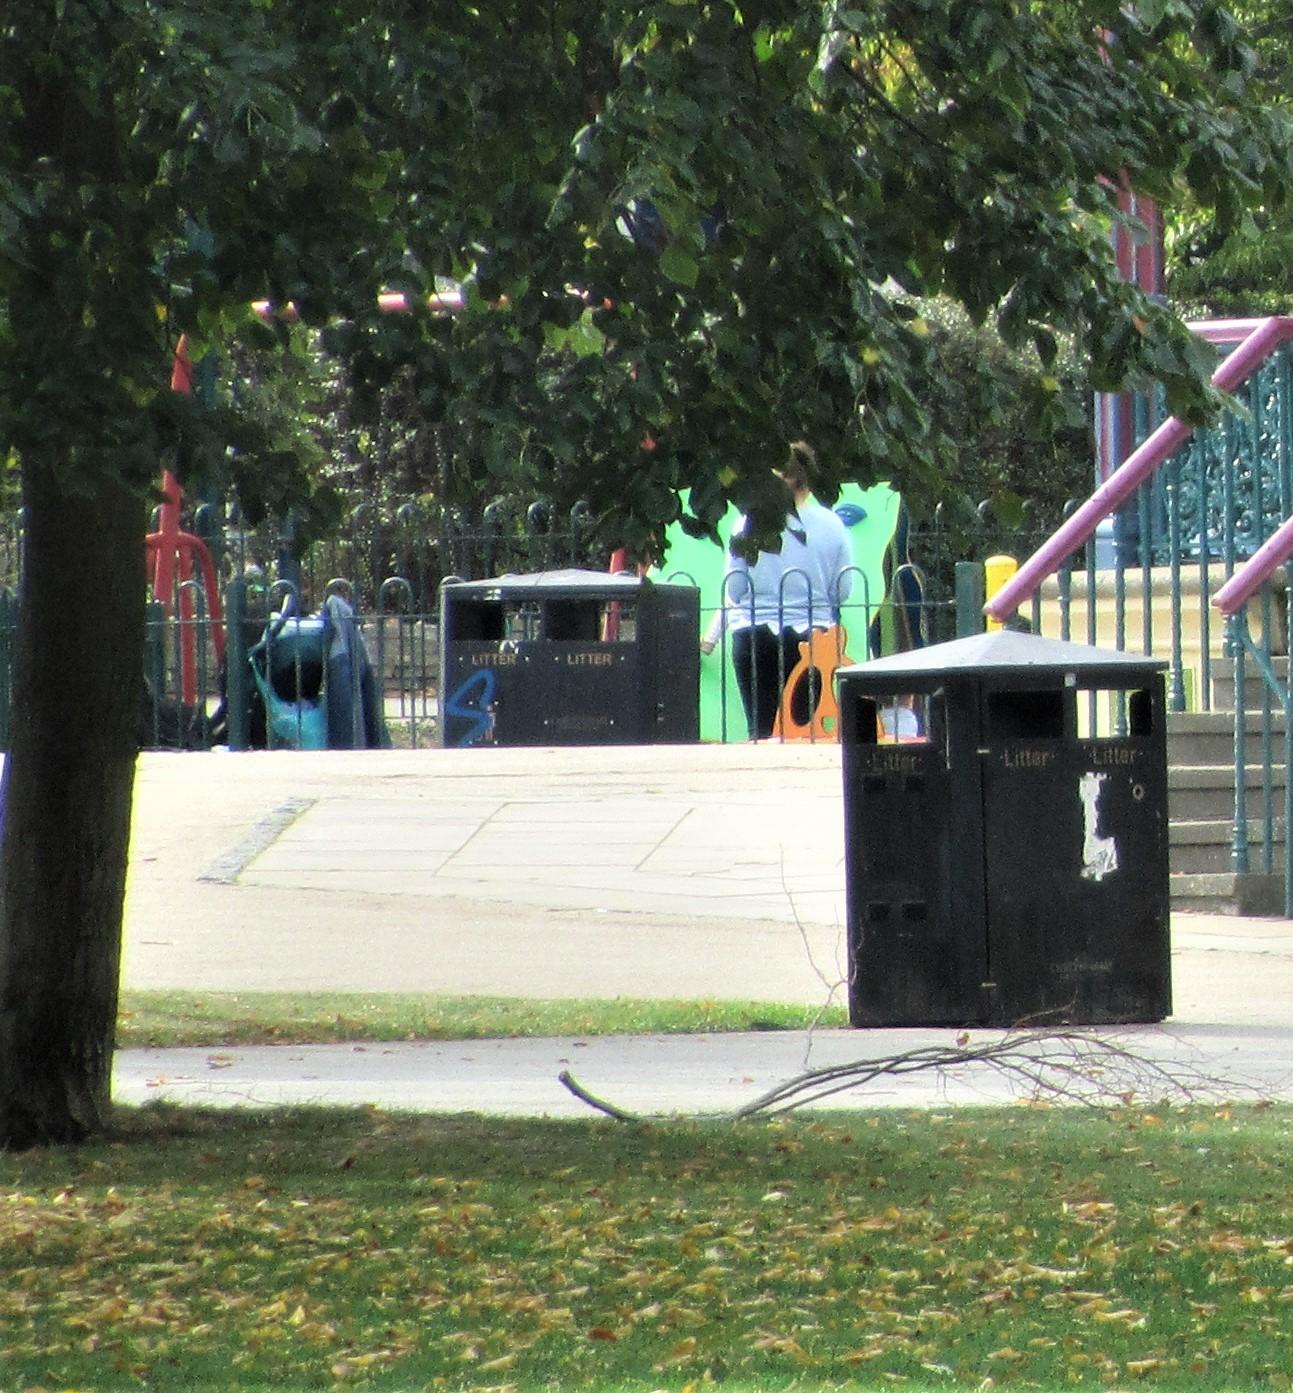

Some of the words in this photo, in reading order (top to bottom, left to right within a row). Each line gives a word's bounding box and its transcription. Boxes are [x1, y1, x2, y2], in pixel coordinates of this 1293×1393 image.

[472, 653, 516, 666] LITTER
[567, 653, 612, 666] LITTER
[1004, 748, 1049, 768] Litter
[1092, 746, 1137, 765] Litter
